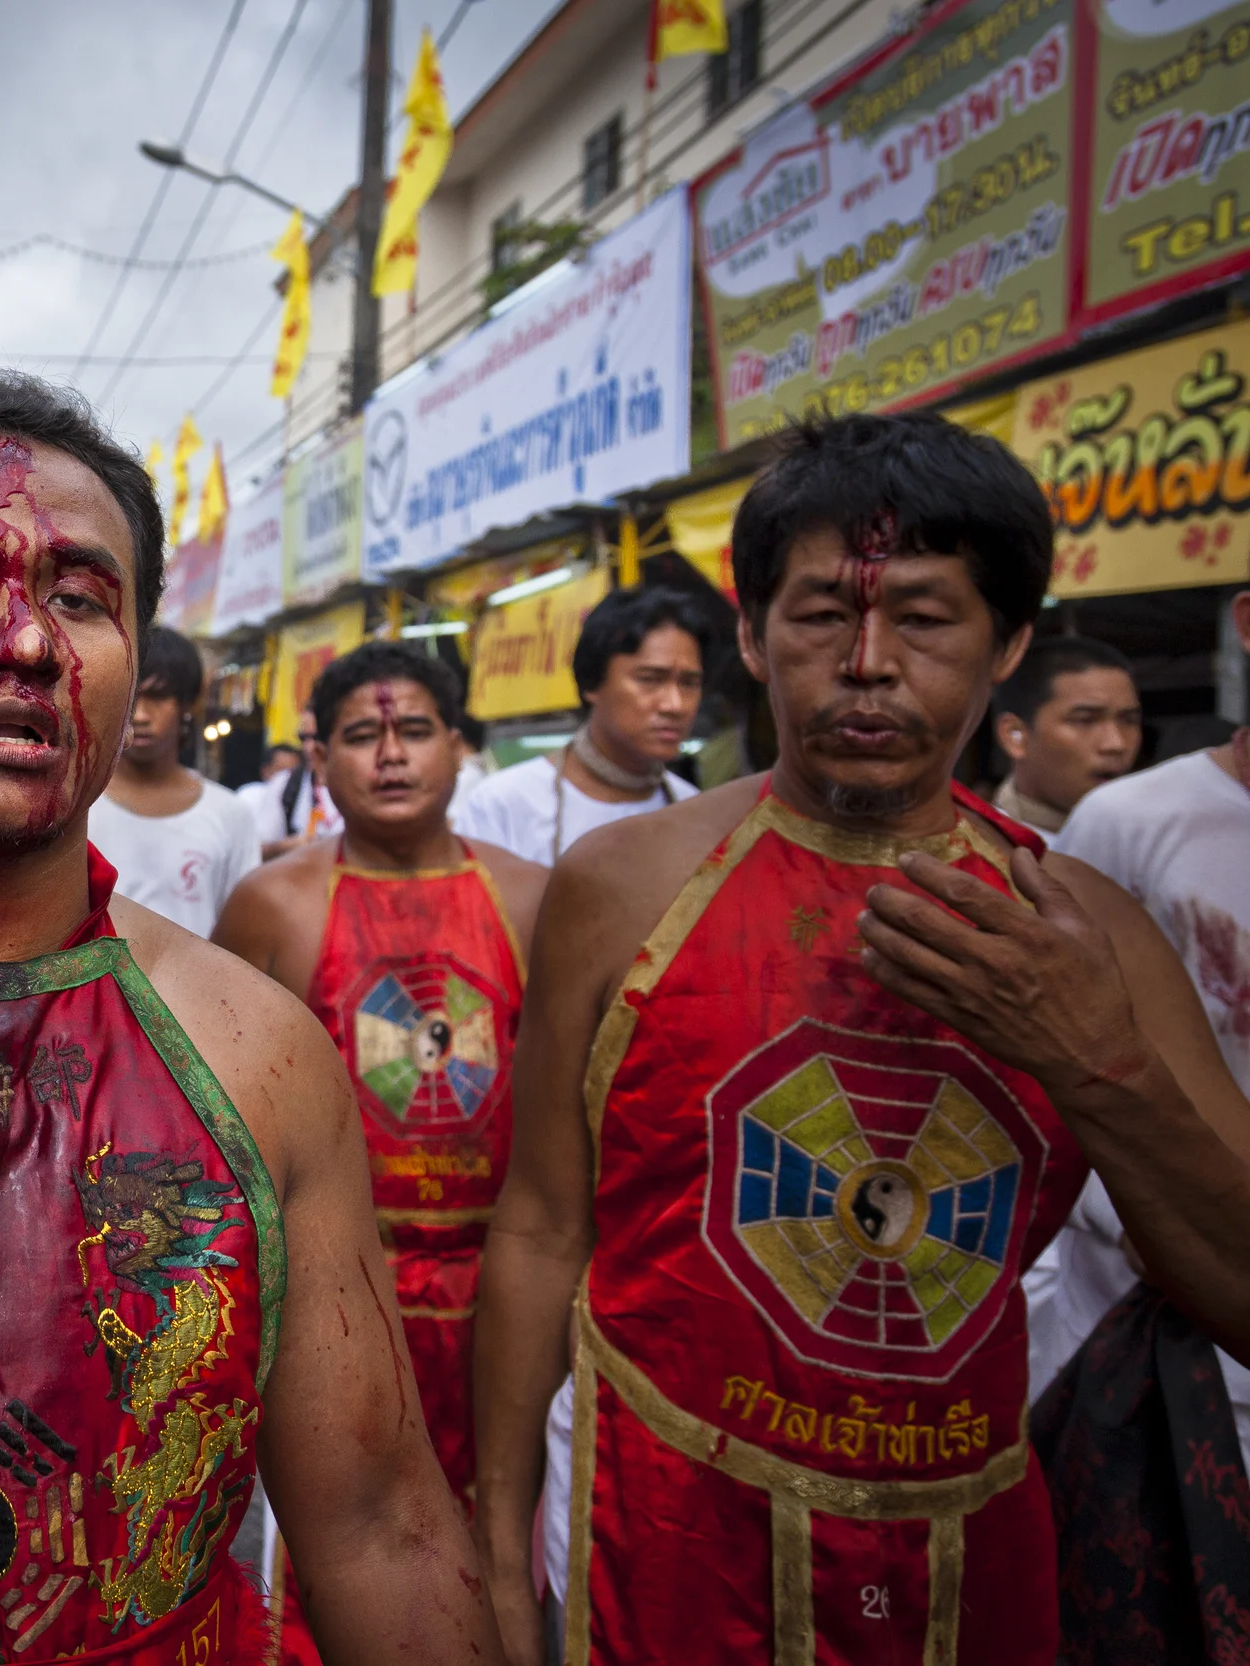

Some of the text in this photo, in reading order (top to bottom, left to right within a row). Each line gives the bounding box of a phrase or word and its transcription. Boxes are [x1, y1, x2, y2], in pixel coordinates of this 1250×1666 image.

[880, 34, 1064, 184] บายพาส
[720, 1375, 989, 1464] ศาลเจ้าท่าเรือ
[175, 1596, 221, 1666] 157
